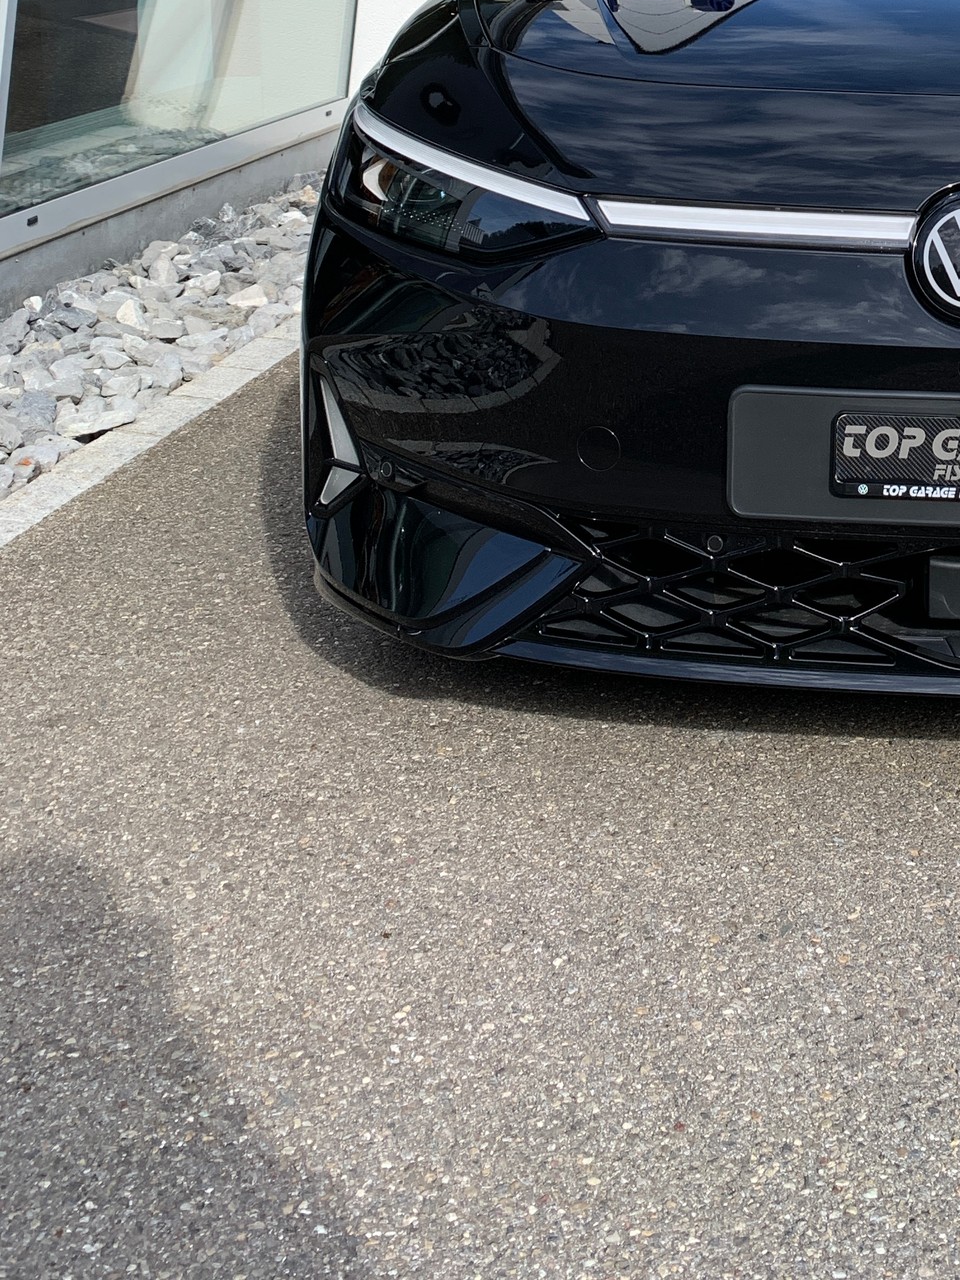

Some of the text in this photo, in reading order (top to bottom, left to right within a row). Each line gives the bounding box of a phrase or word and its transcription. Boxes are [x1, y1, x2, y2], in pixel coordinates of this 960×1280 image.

[843, 425, 926, 459] TOP
[882, 484, 908, 497] TOP
[909, 485, 957, 499] GARAGE
